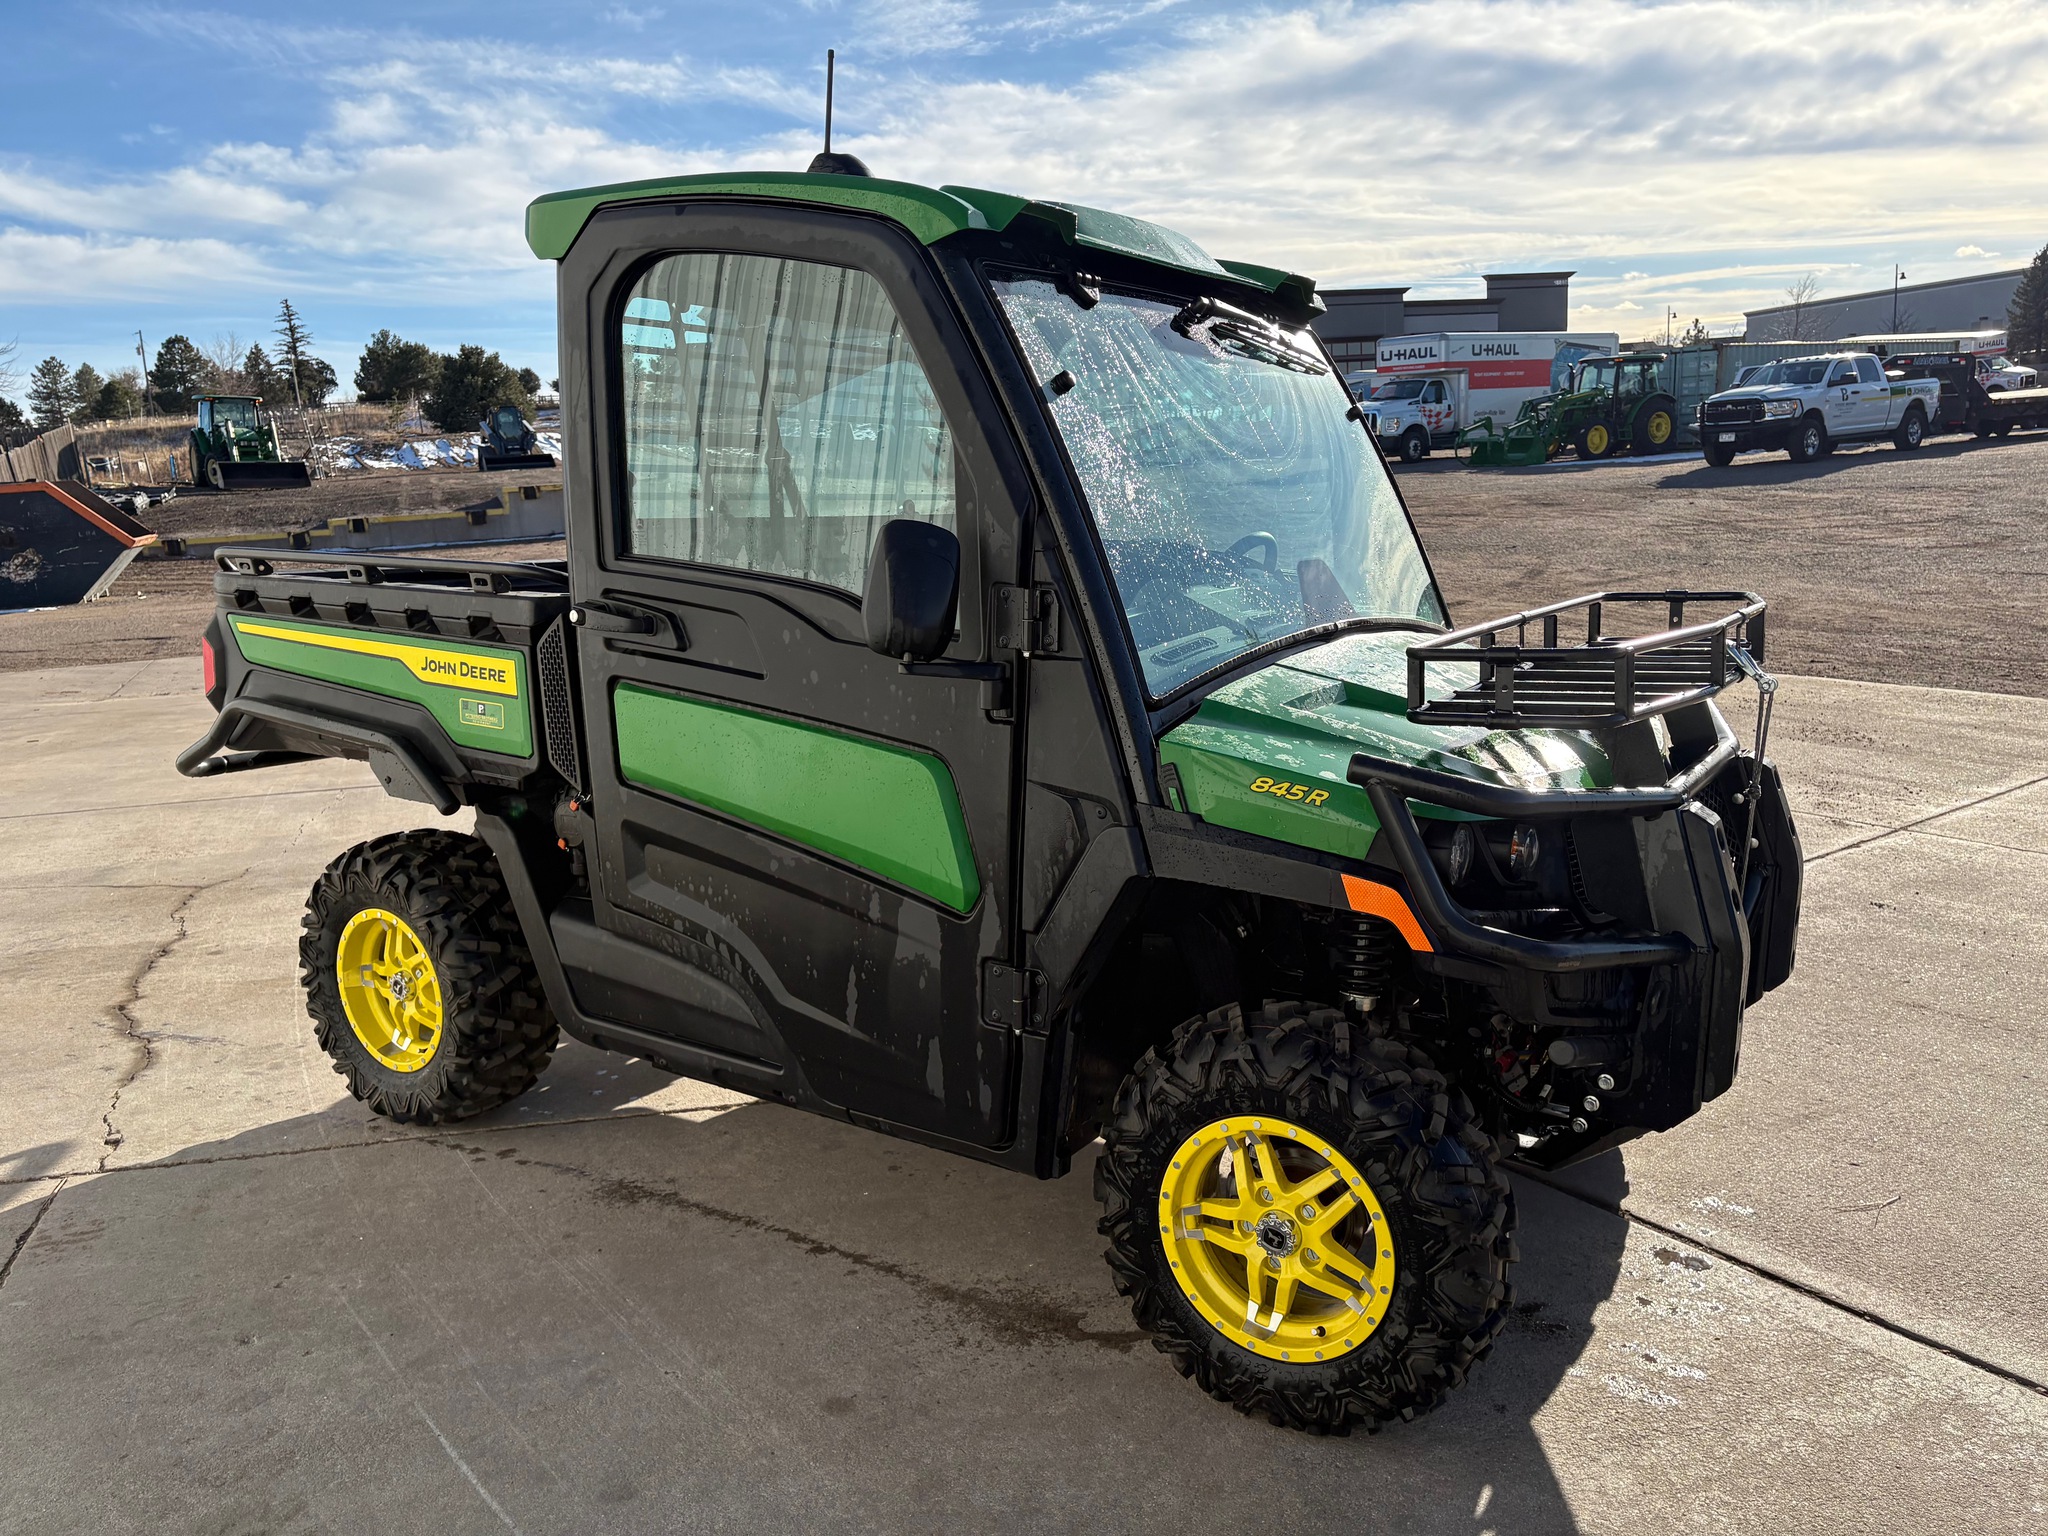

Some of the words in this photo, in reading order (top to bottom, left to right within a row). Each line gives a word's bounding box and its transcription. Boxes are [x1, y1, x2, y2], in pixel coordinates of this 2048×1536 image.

[1471, 343, 1520, 357] U-HAUL
[1978, 339, 2005, 349] U-HAUL
[1381, 346, 1438, 362] U-HAUL
[421, 656, 457, 676] JOHN
[459, 661, 506, 683] DEERE
